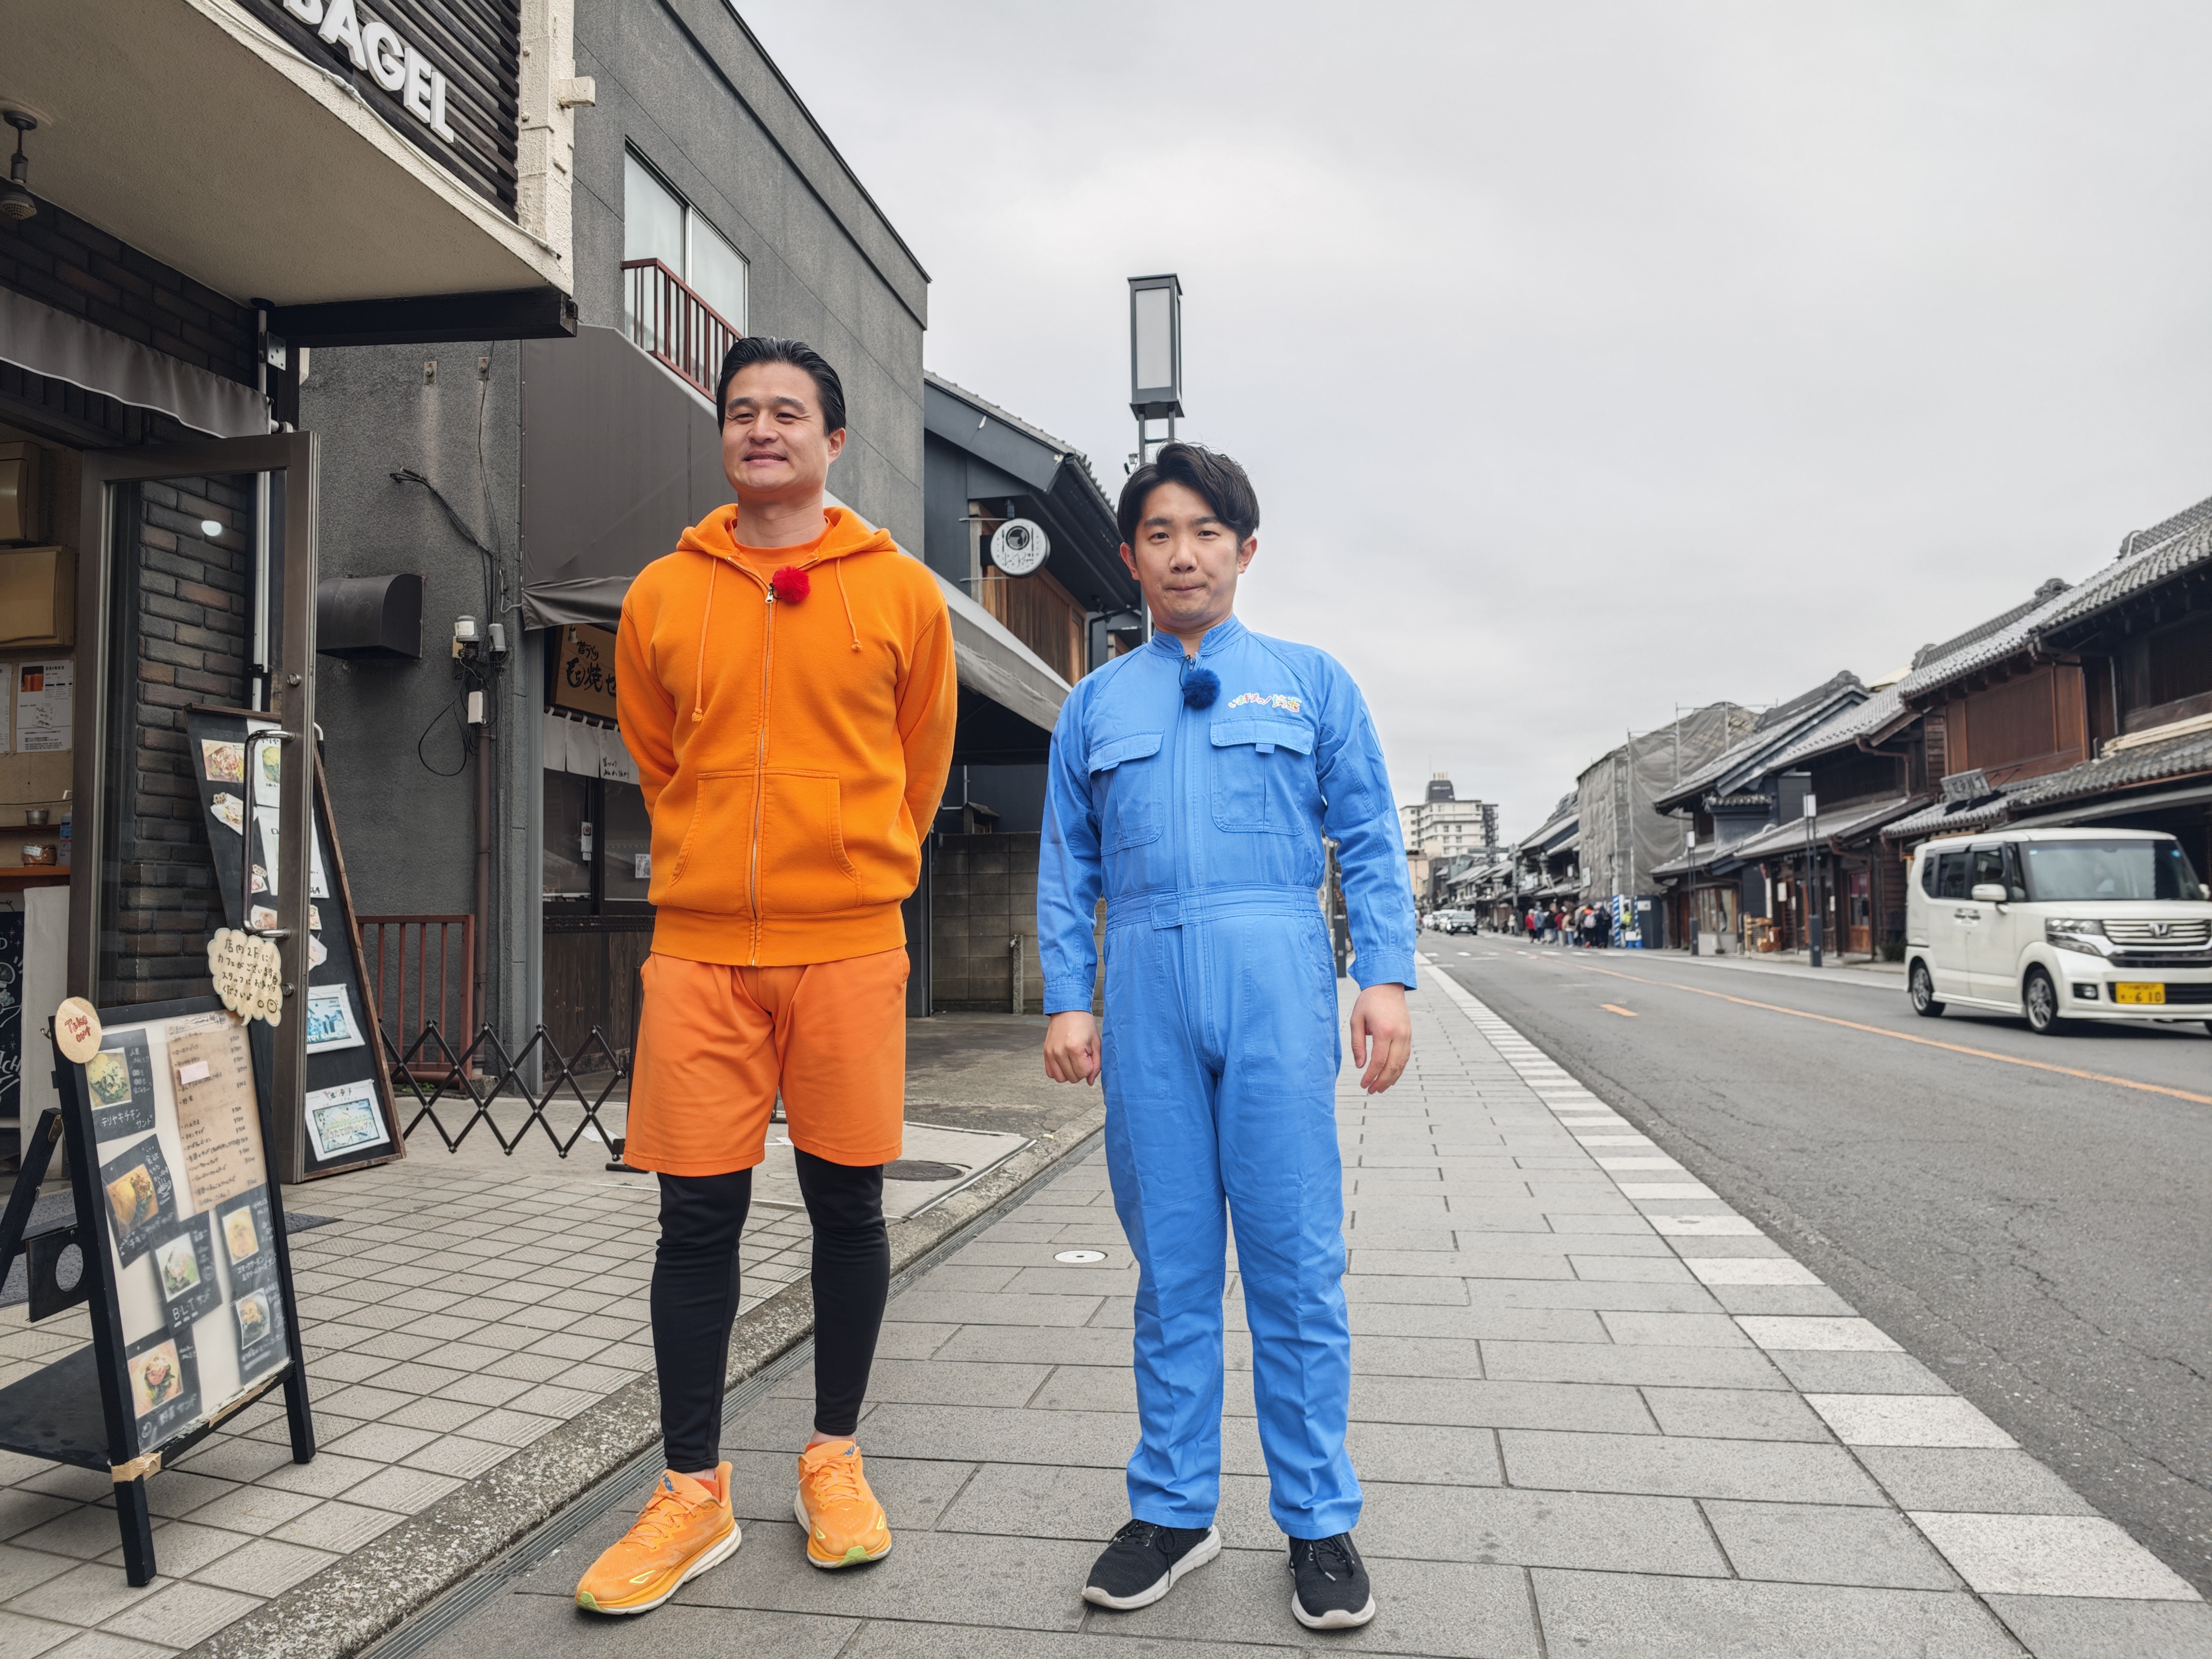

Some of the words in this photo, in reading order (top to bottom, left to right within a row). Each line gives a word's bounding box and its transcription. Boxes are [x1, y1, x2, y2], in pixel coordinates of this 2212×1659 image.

[64, 1015, 89, 1034] Take
[102, 1109, 141, 1127] テリヤキチキン
